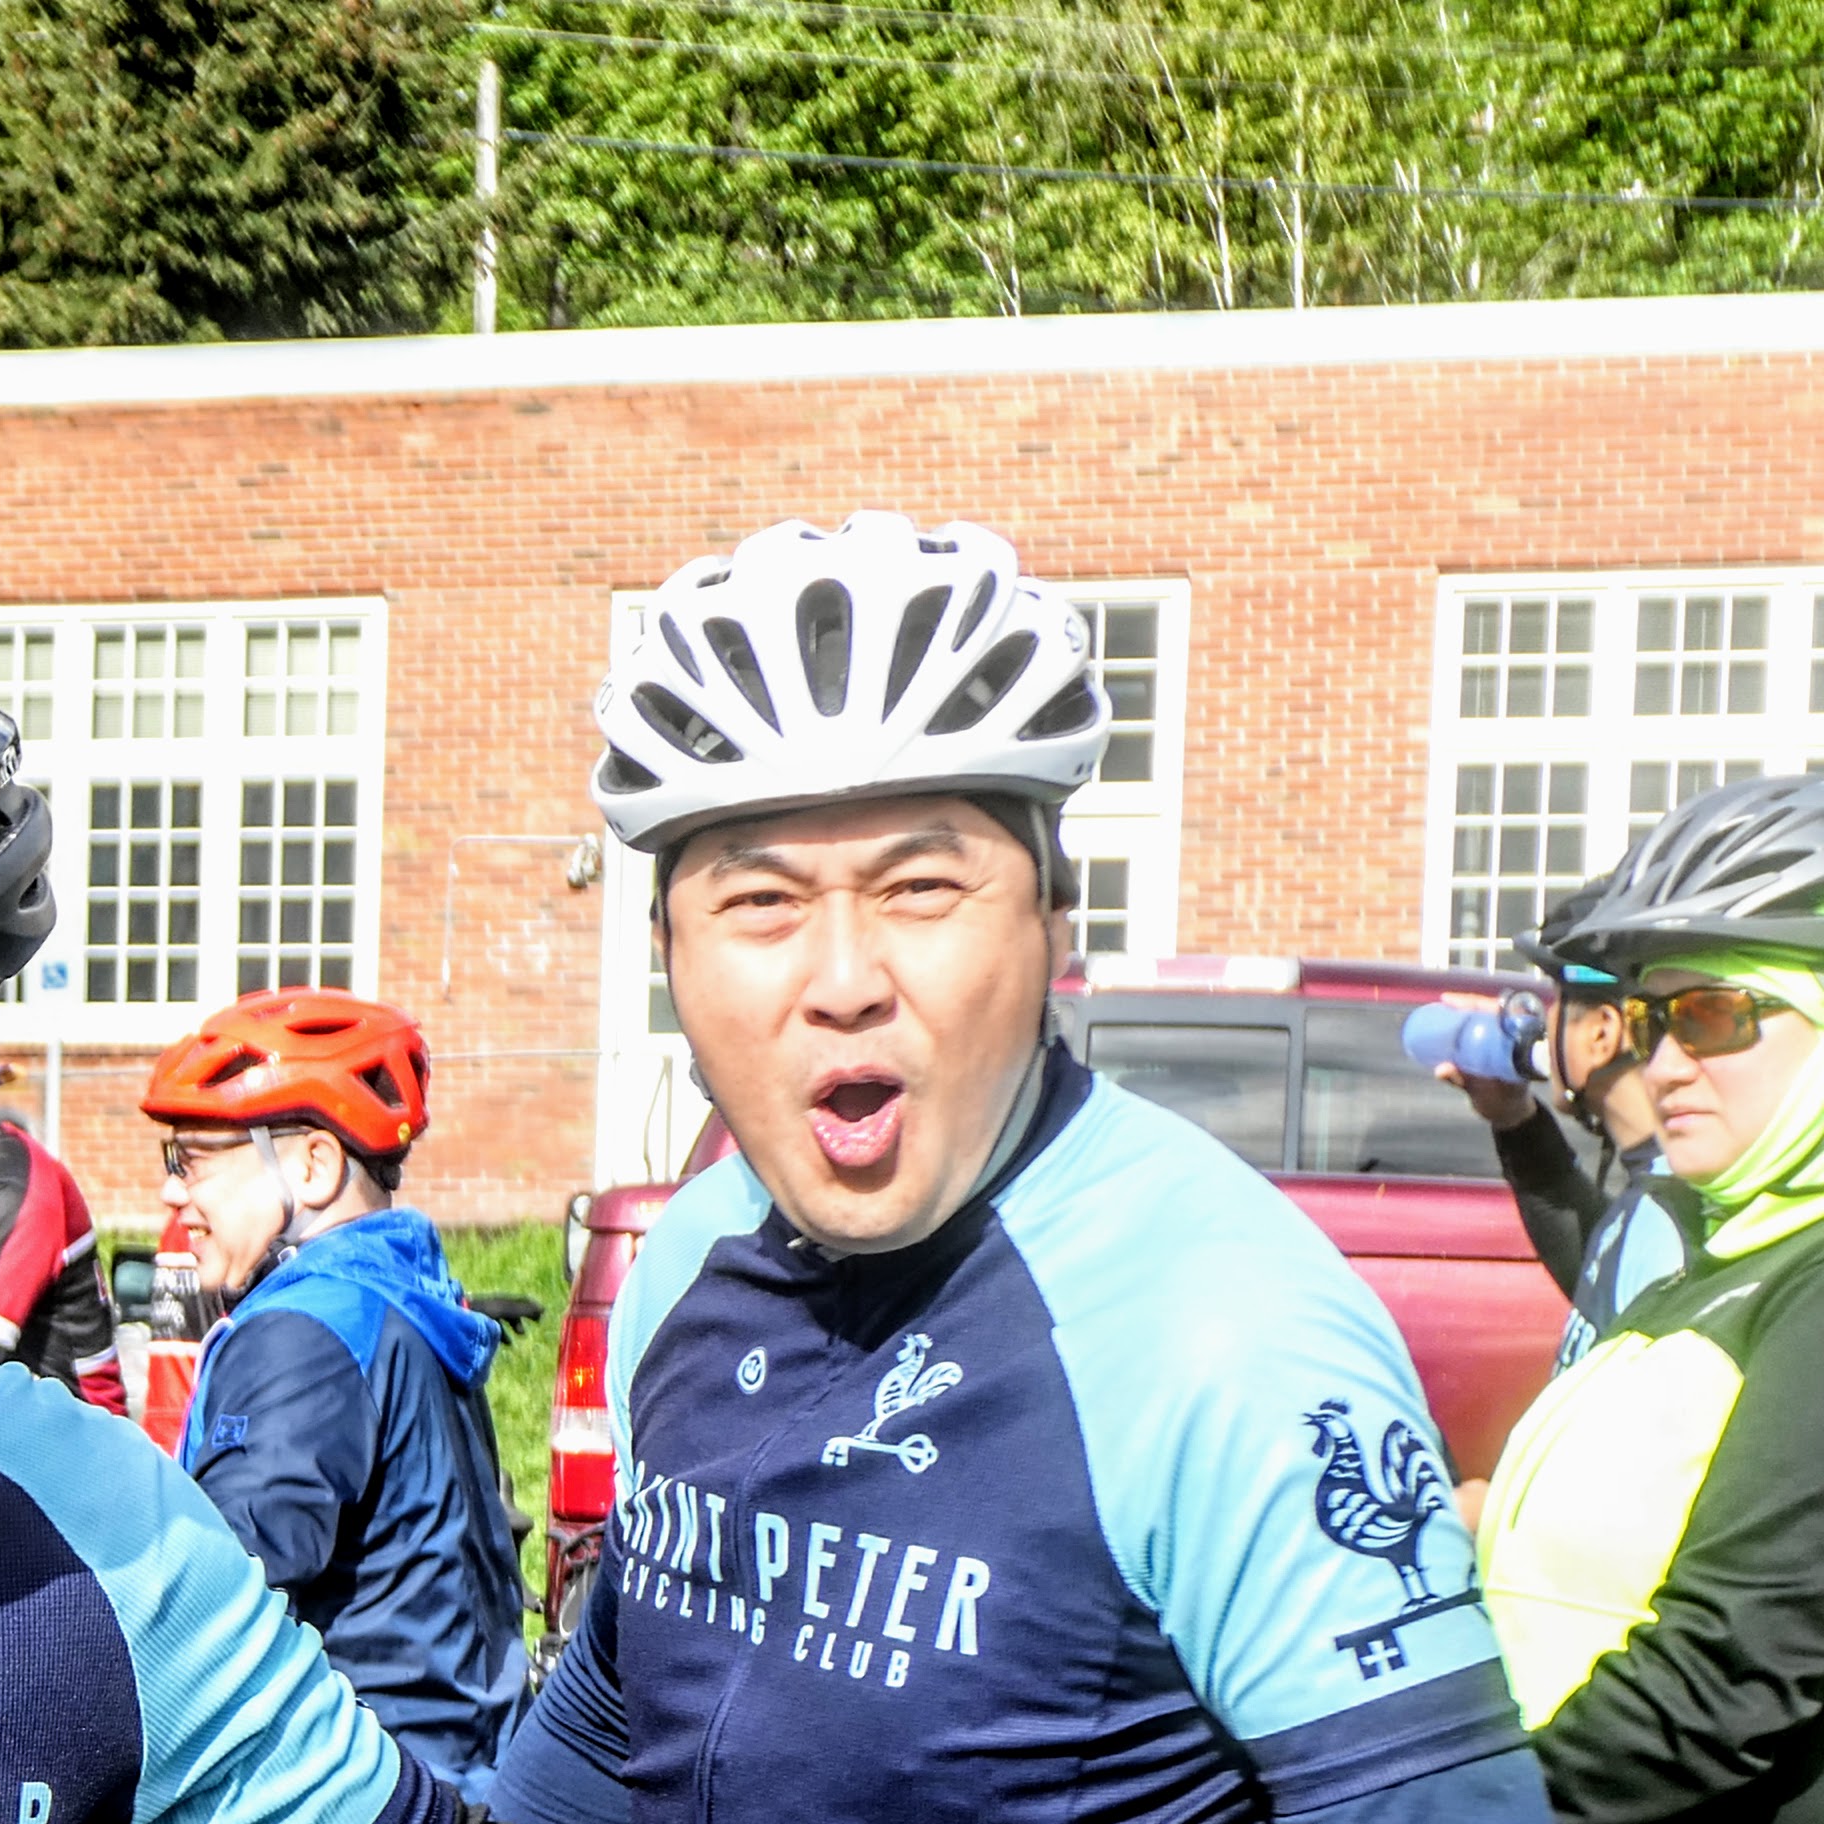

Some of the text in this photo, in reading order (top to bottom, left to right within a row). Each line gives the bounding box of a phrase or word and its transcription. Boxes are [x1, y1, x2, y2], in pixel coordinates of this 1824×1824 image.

[621, 1556, 911, 1689] CYCLING CLUB
[754, 1511, 991, 1656] PETER
